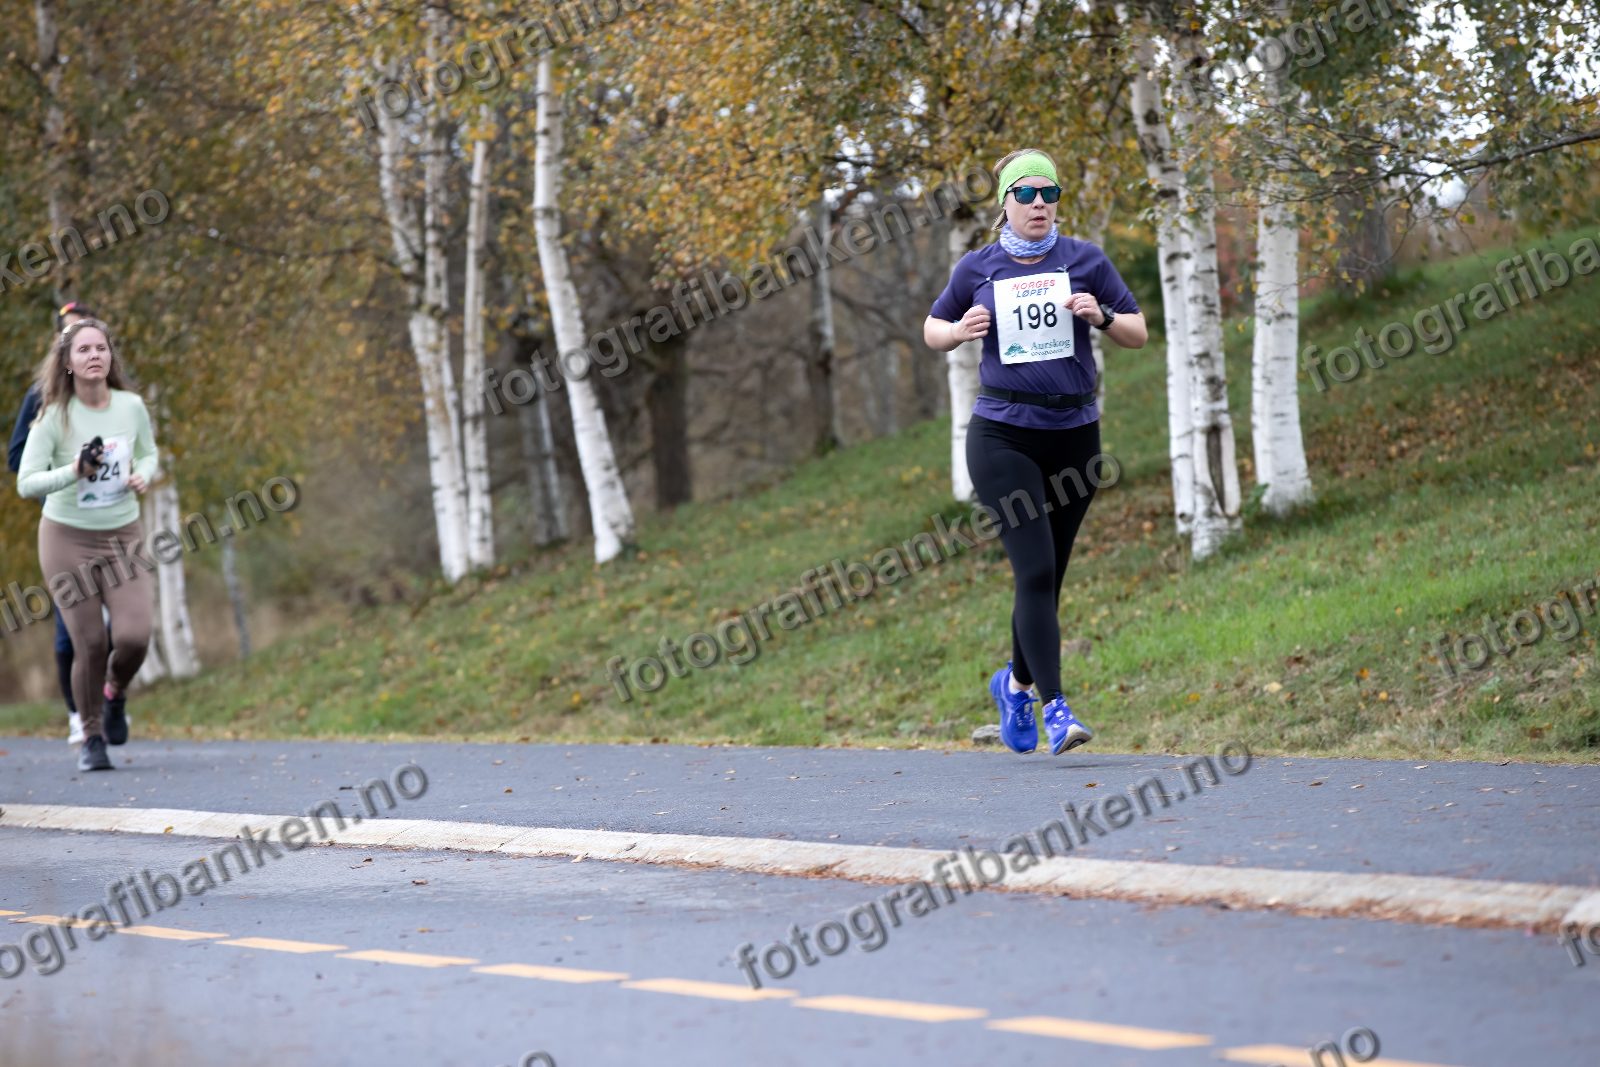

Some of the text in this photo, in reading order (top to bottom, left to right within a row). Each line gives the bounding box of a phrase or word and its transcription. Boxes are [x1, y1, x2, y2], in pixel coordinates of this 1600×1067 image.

[1012, 279, 1056, 290] NORGES
[1016, 288, 1049, 298] LØPET
[1013, 302, 1058, 330] 198
